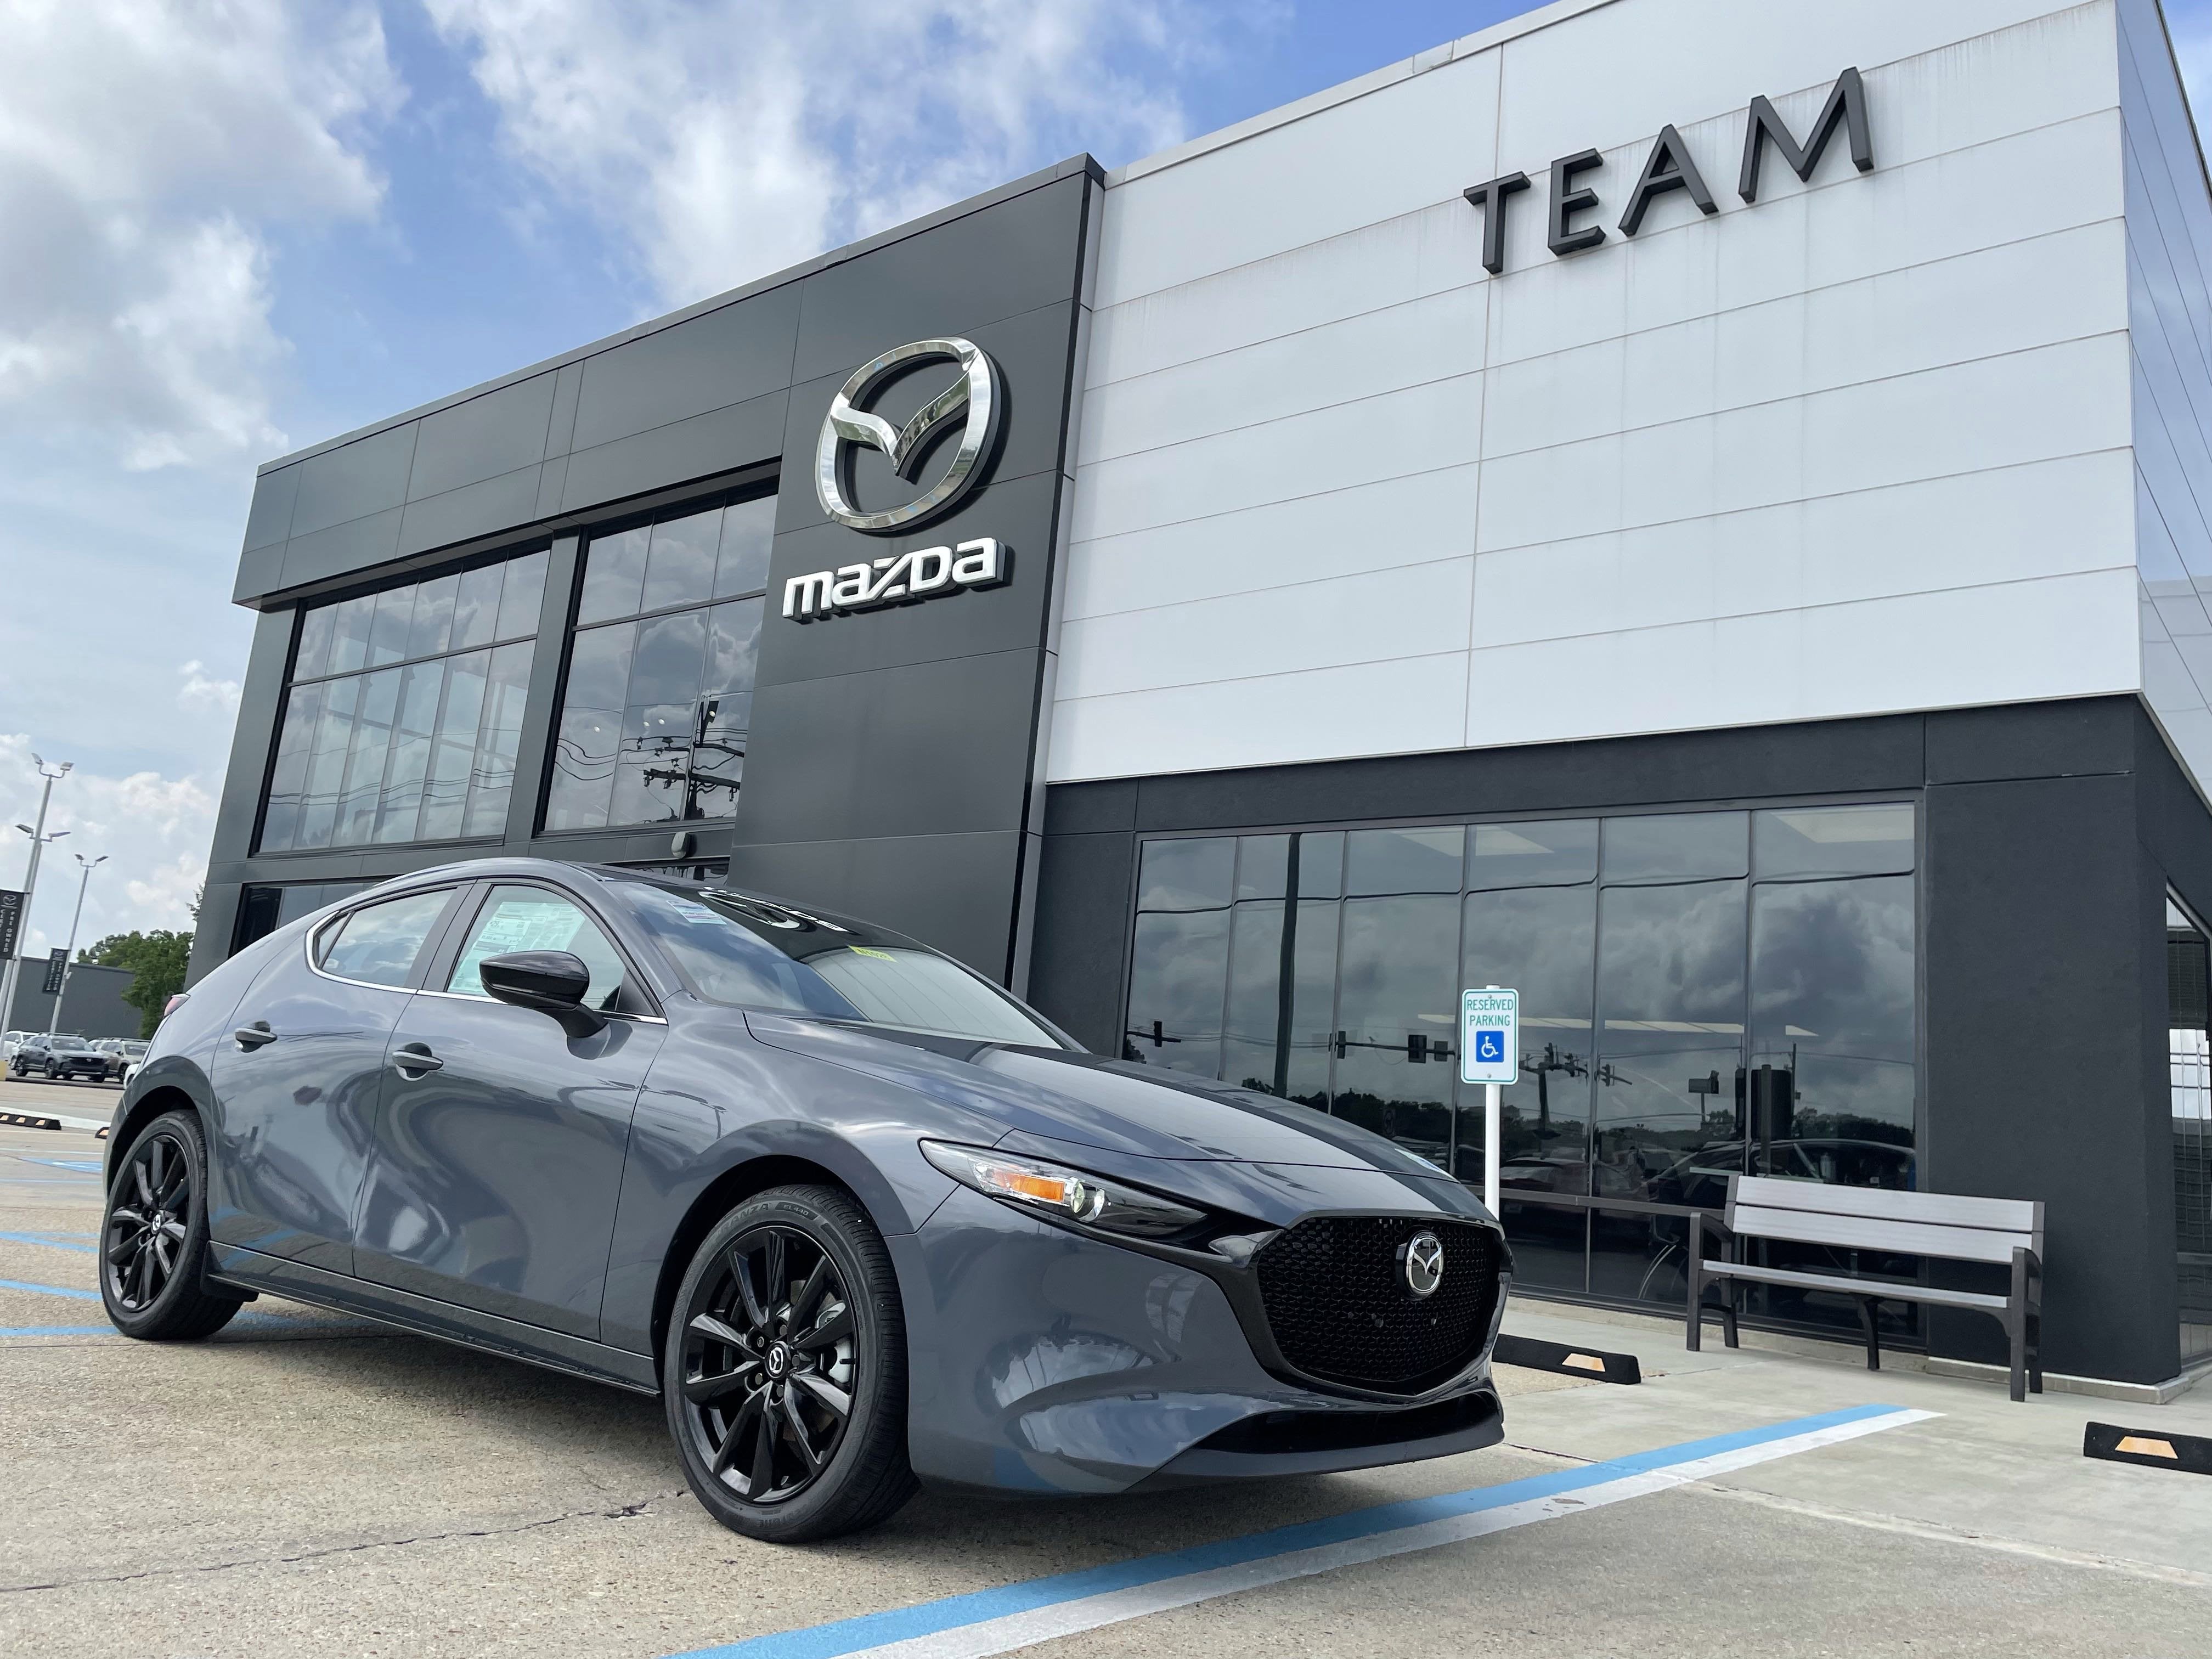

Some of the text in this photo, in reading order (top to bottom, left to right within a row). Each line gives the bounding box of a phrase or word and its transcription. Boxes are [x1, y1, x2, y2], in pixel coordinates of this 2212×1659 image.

[1464, 66, 1874, 274] TEAM
[1467, 999, 1514, 1011] RESERVED
[1470, 1015, 1510, 1026] PARKING
